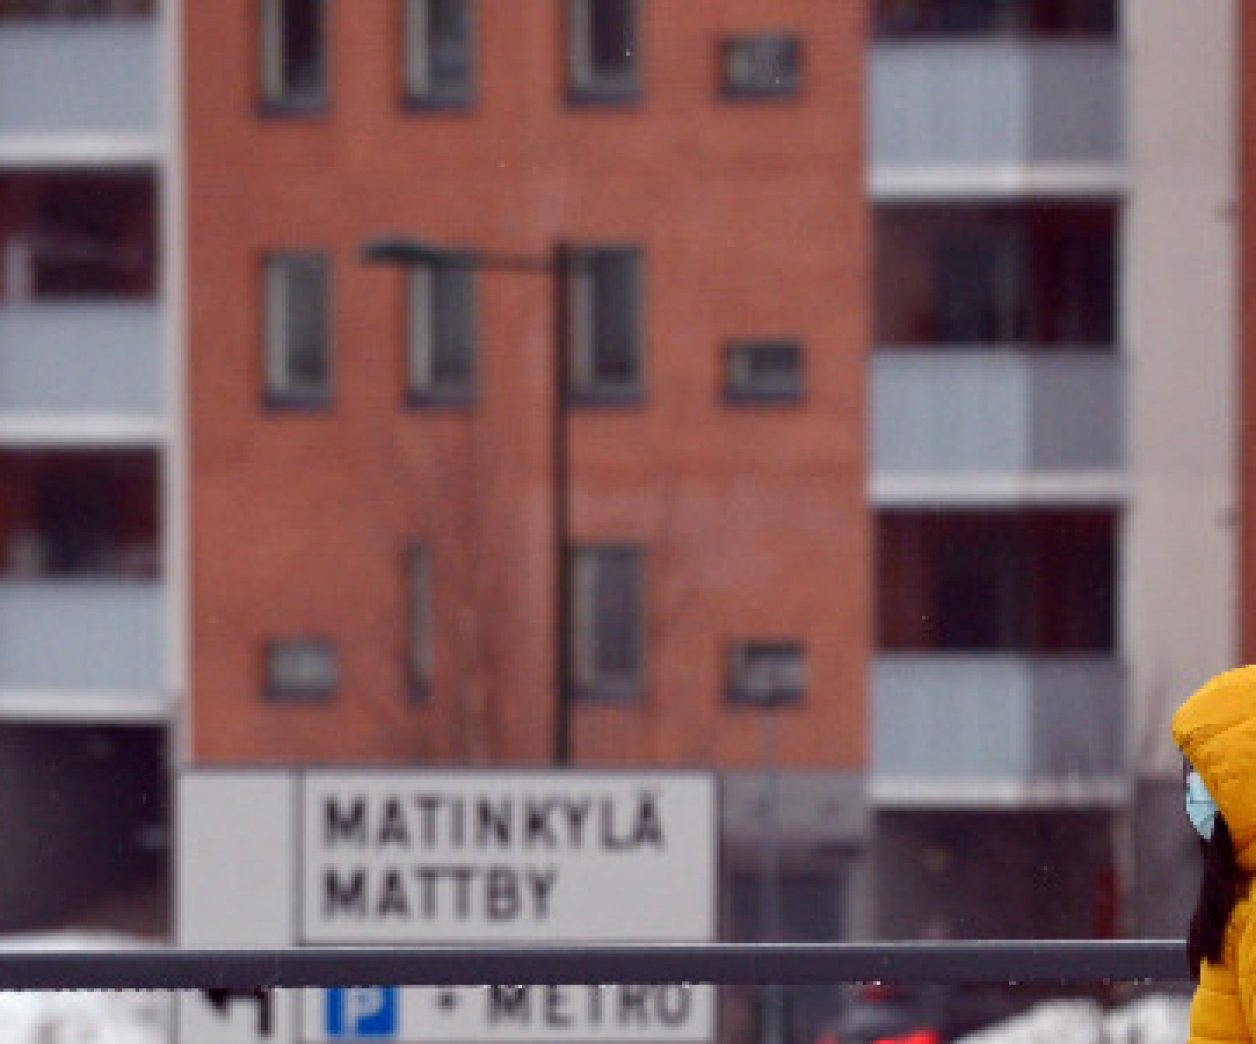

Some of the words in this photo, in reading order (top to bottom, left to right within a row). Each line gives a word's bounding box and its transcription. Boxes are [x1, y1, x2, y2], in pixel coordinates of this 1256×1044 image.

[322, 785, 666, 851] MATINKYLÄ
[322, 865, 558, 921] MATTBY
[485, 984, 694, 1030] METRO
